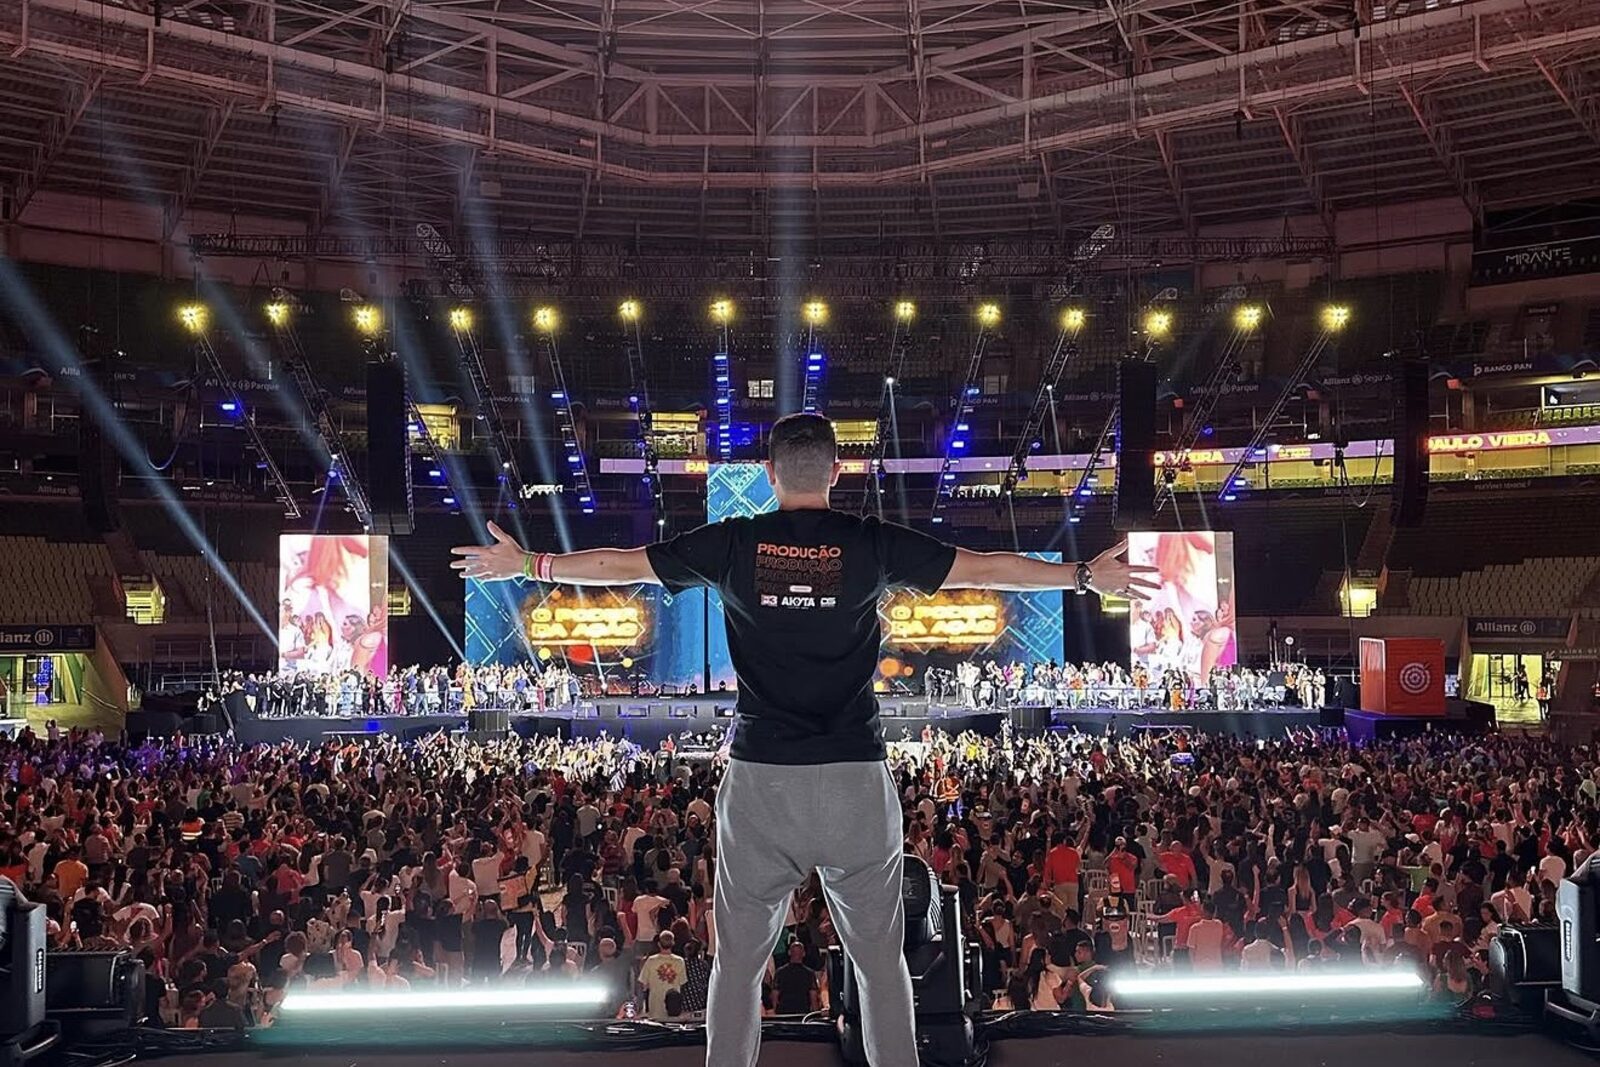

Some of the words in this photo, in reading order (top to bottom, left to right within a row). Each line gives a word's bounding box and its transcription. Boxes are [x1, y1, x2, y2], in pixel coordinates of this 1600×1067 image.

[1505, 247, 1571, 265] MIRANTE
[1484, 364, 1513, 373] BANCO
[1513, 362, 1533, 370] PAN
[757, 543, 842, 560] PRODUÇÃO
[1475, 621, 1518, 633] Allianz
